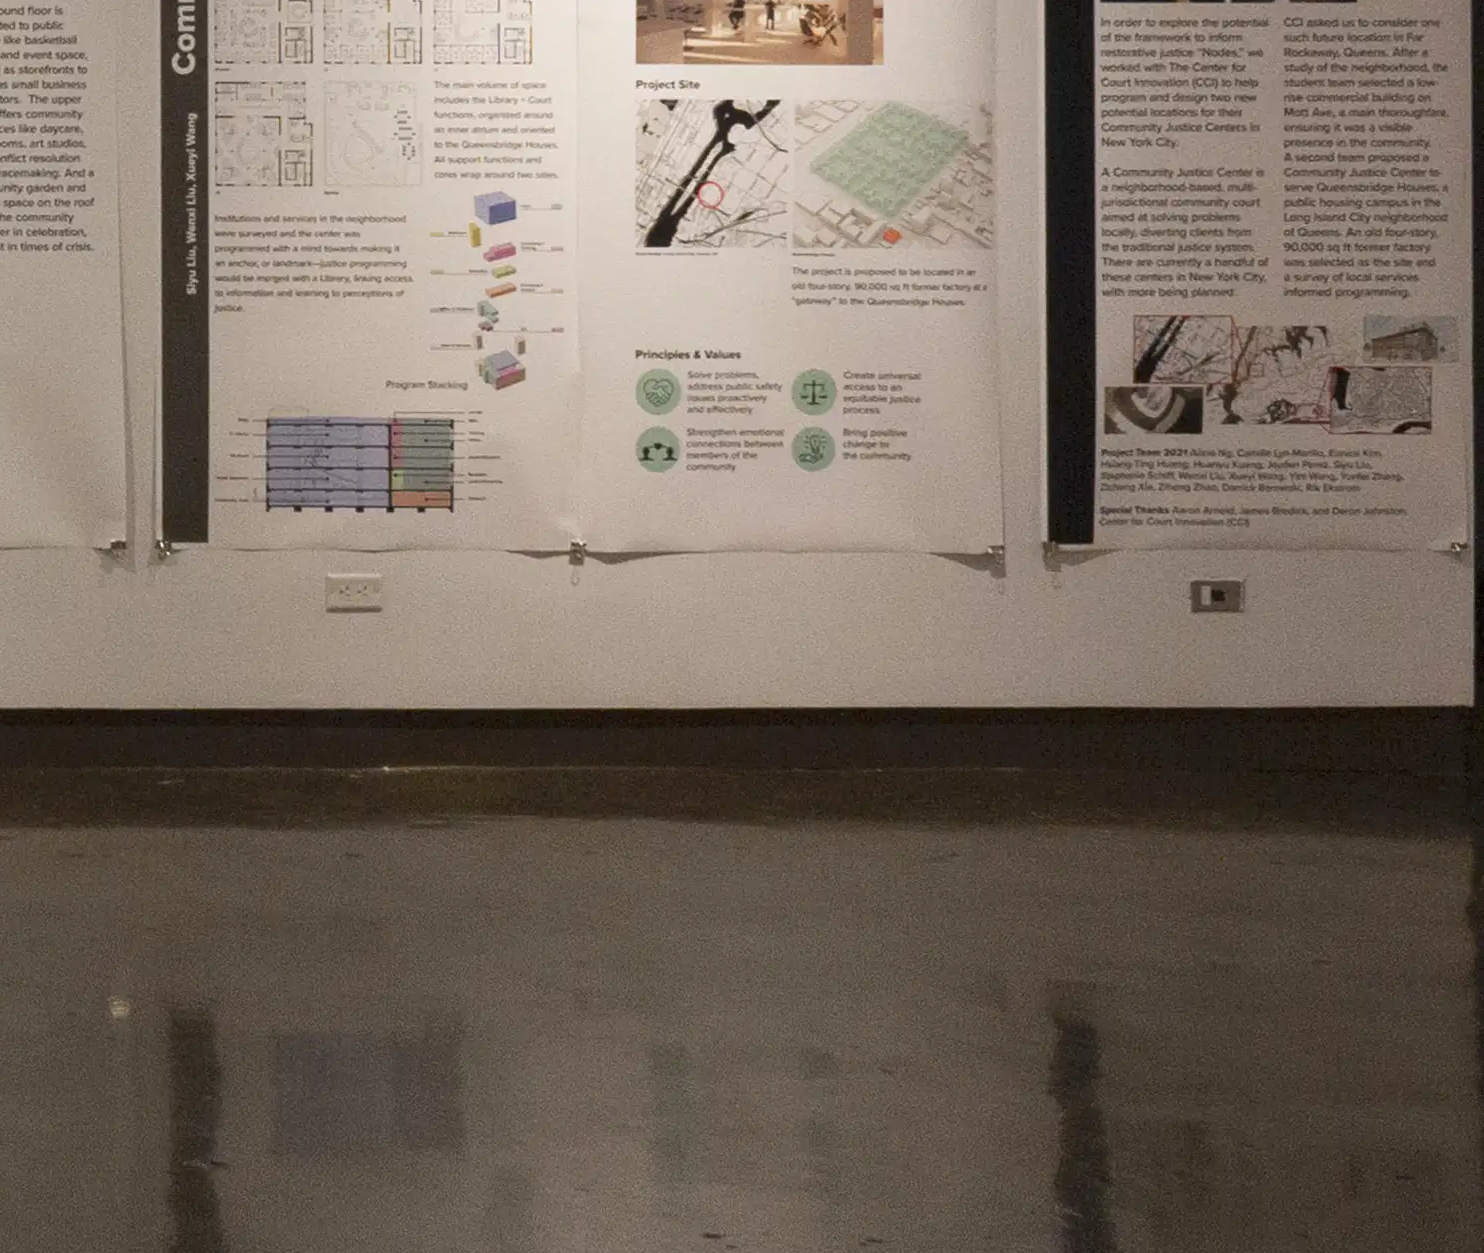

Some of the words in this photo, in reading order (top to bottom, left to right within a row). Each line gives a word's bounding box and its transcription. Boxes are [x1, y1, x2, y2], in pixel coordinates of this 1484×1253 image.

[636, 80, 675, 90] Project
[679, 80, 700, 89] Site
[636, 350, 690, 360] Principles
[693, 351, 701, 359] &
[705, 351, 741, 359] Values
[386, 380, 425, 390] Program
